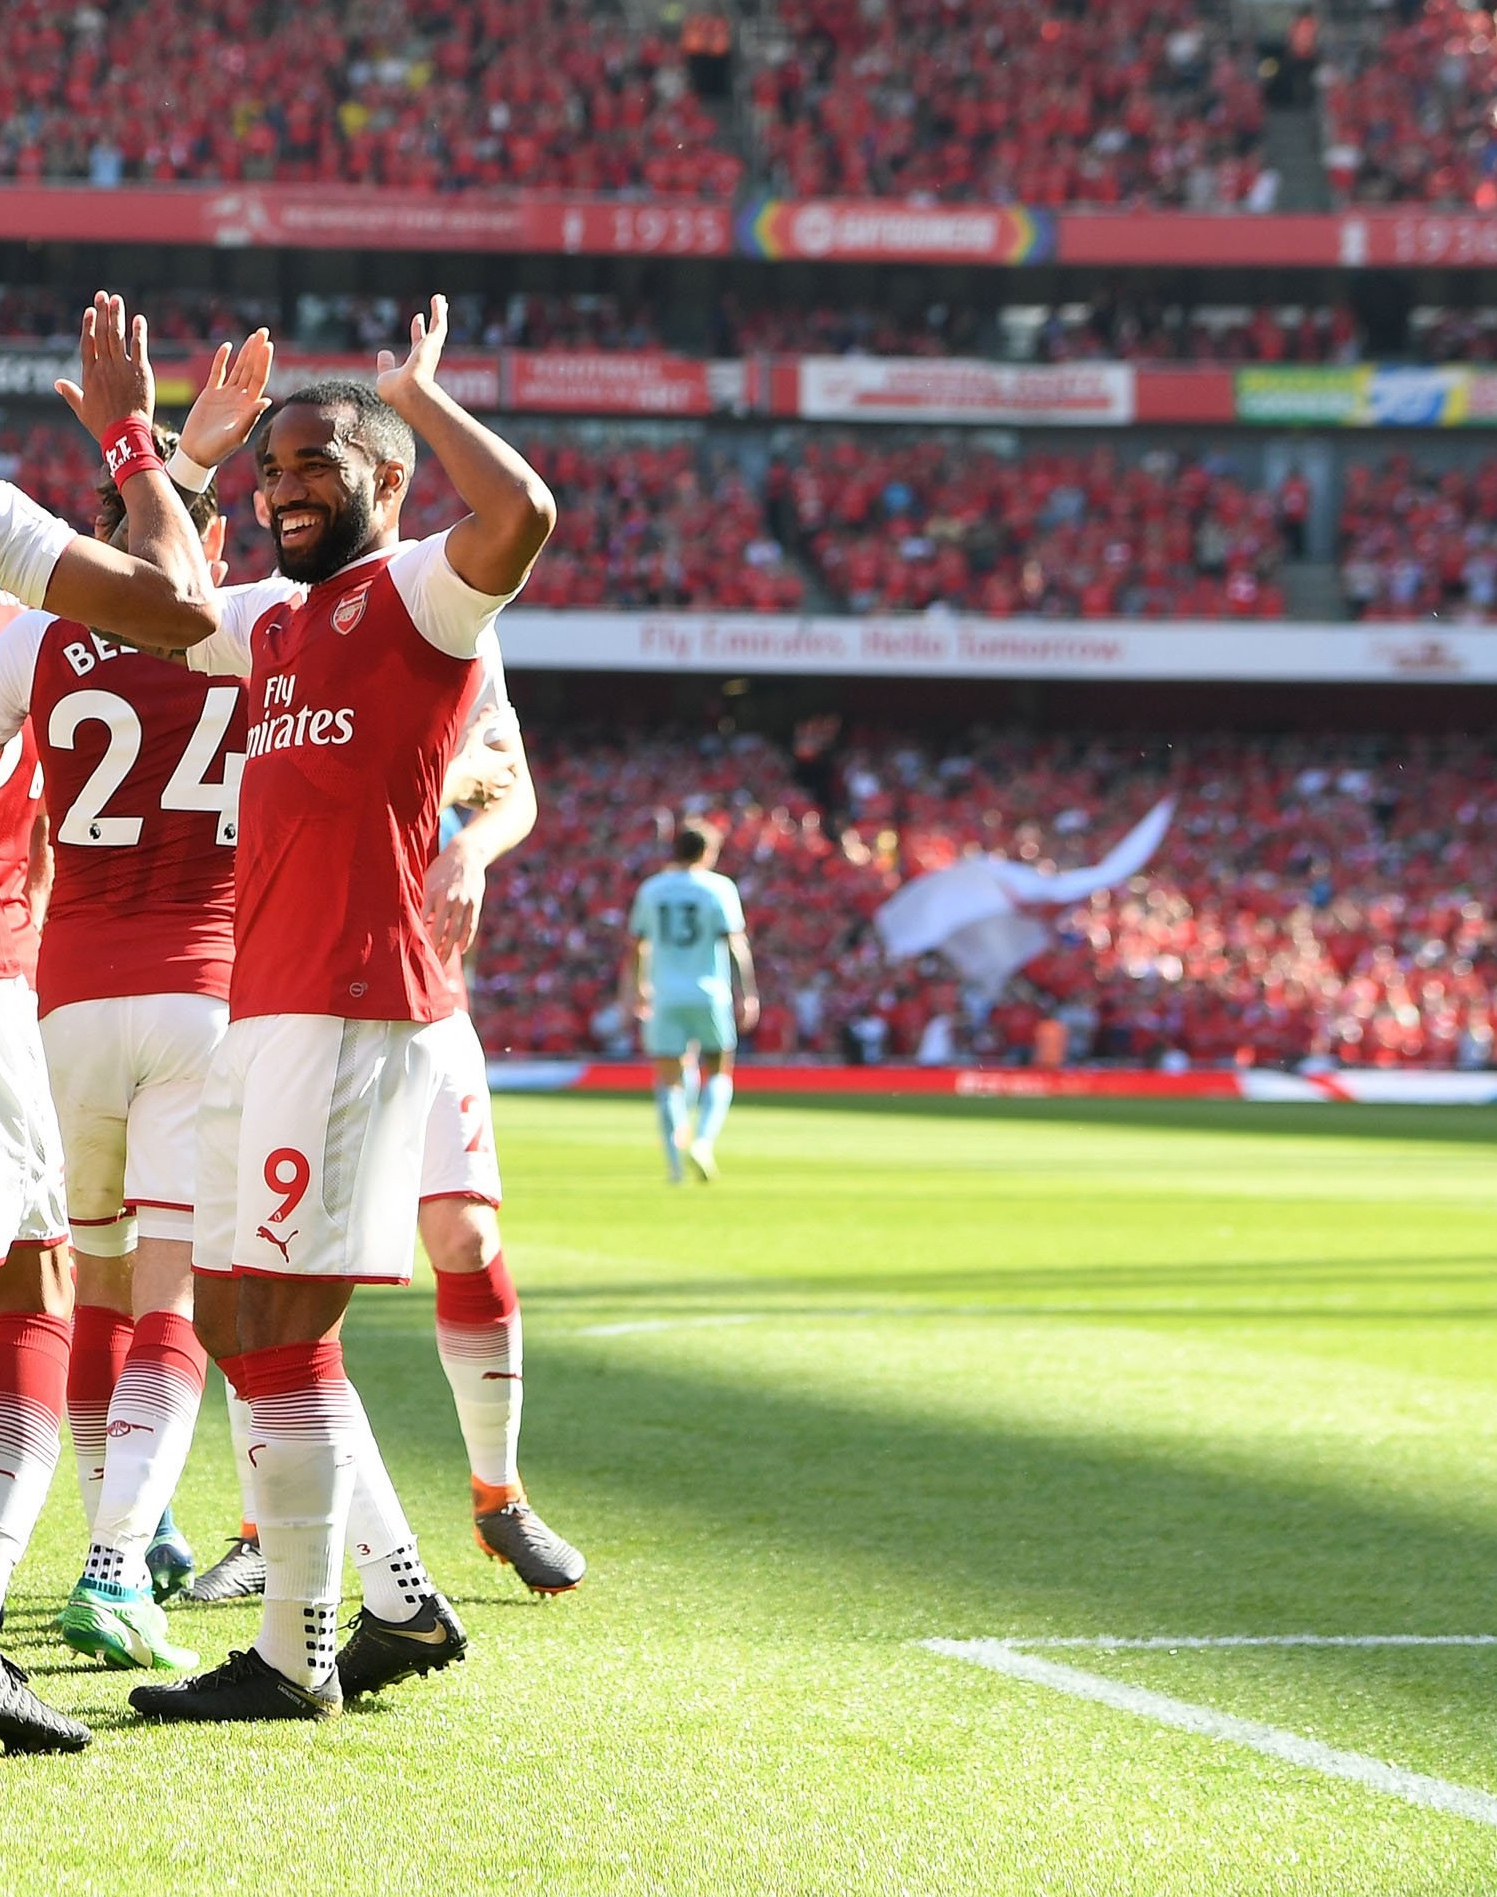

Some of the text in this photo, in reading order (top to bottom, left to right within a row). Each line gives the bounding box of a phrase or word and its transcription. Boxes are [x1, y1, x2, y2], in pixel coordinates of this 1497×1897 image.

[613, 207, 724, 253] 1935
[264, 674, 296, 708] Fly
[48, 689, 246, 847] 24
[658, 902, 702, 946] 13
[264, 1147, 310, 1223] 9
